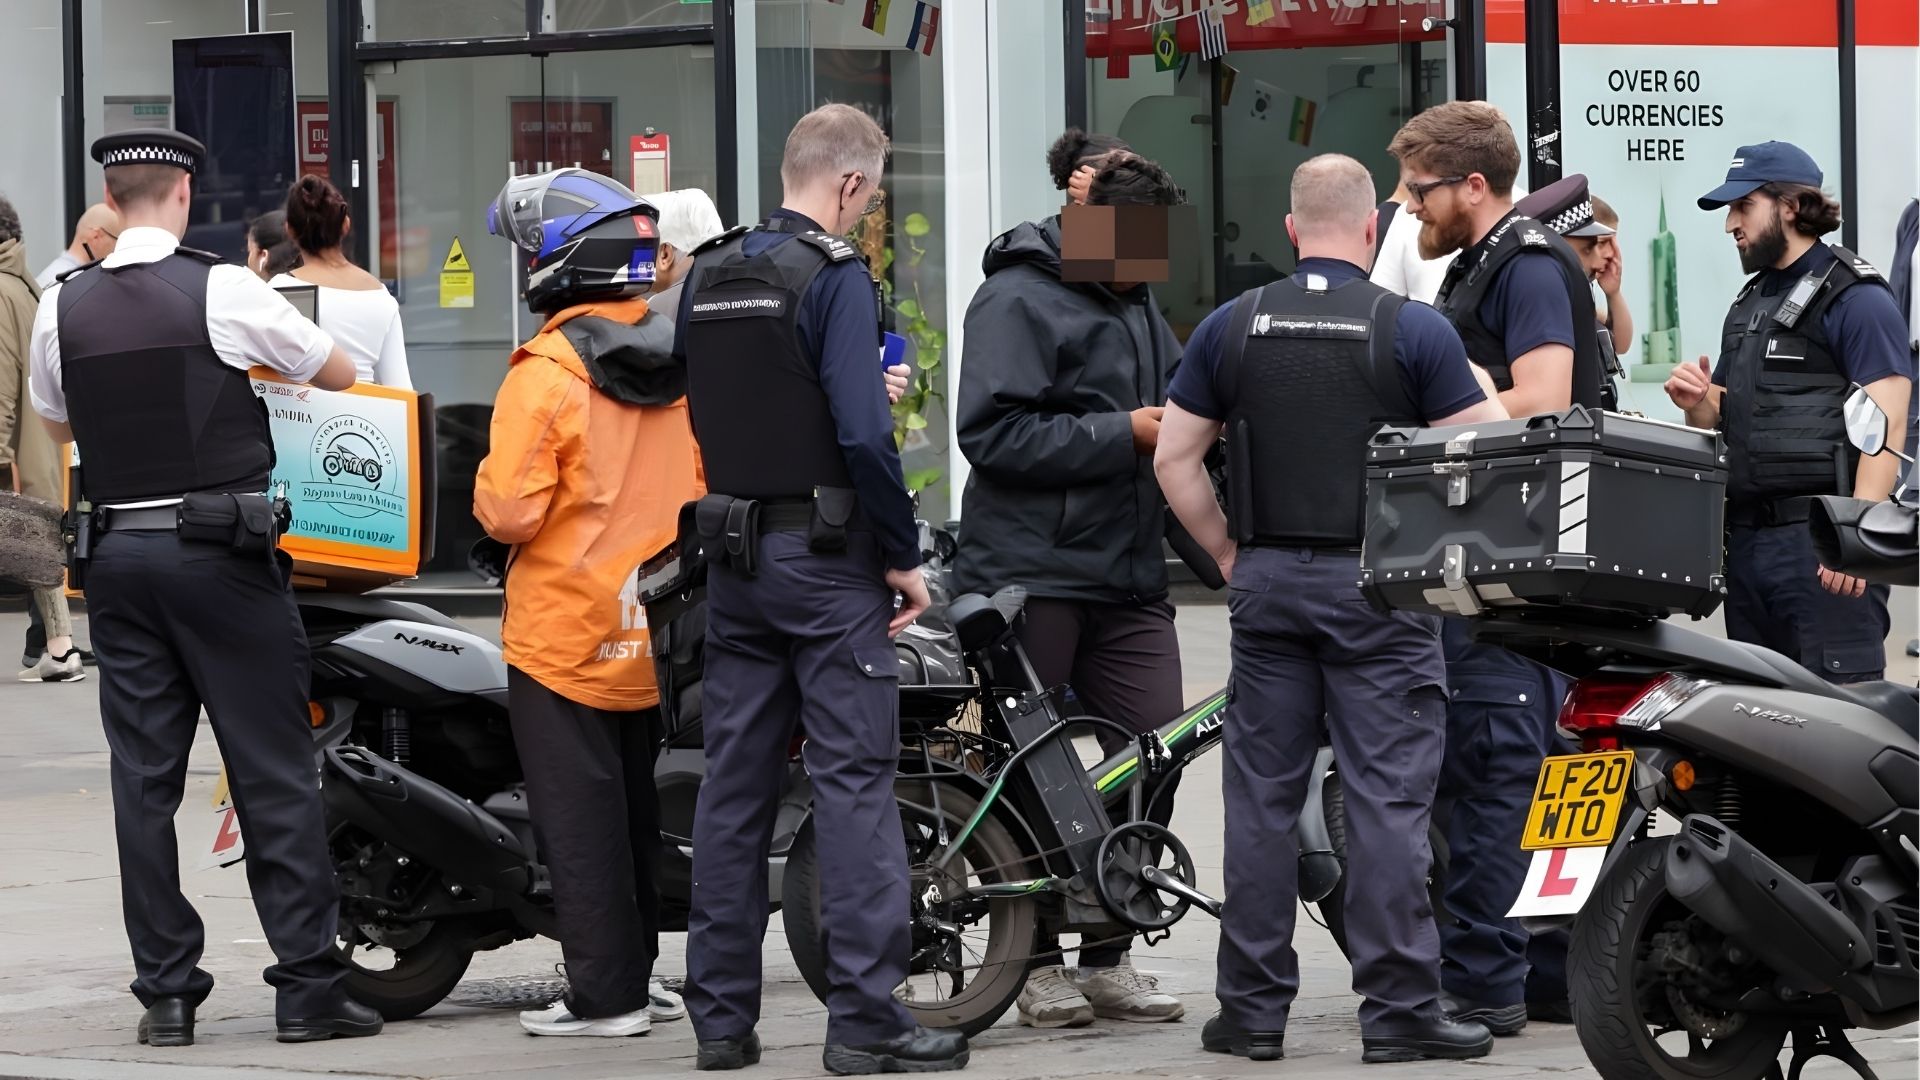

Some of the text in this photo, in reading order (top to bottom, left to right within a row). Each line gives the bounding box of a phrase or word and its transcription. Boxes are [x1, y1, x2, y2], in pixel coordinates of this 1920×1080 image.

[1609, 70, 1699, 92] OVER 60
[1586, 104, 1723, 126] CURRENCIES
[1628, 139, 1684, 160] HERE
[1196, 706, 1226, 738] ALL
[1538, 757, 1627, 801] LF20
[1539, 799, 1606, 840] WTO
[1537, 847, 1578, 898] L
